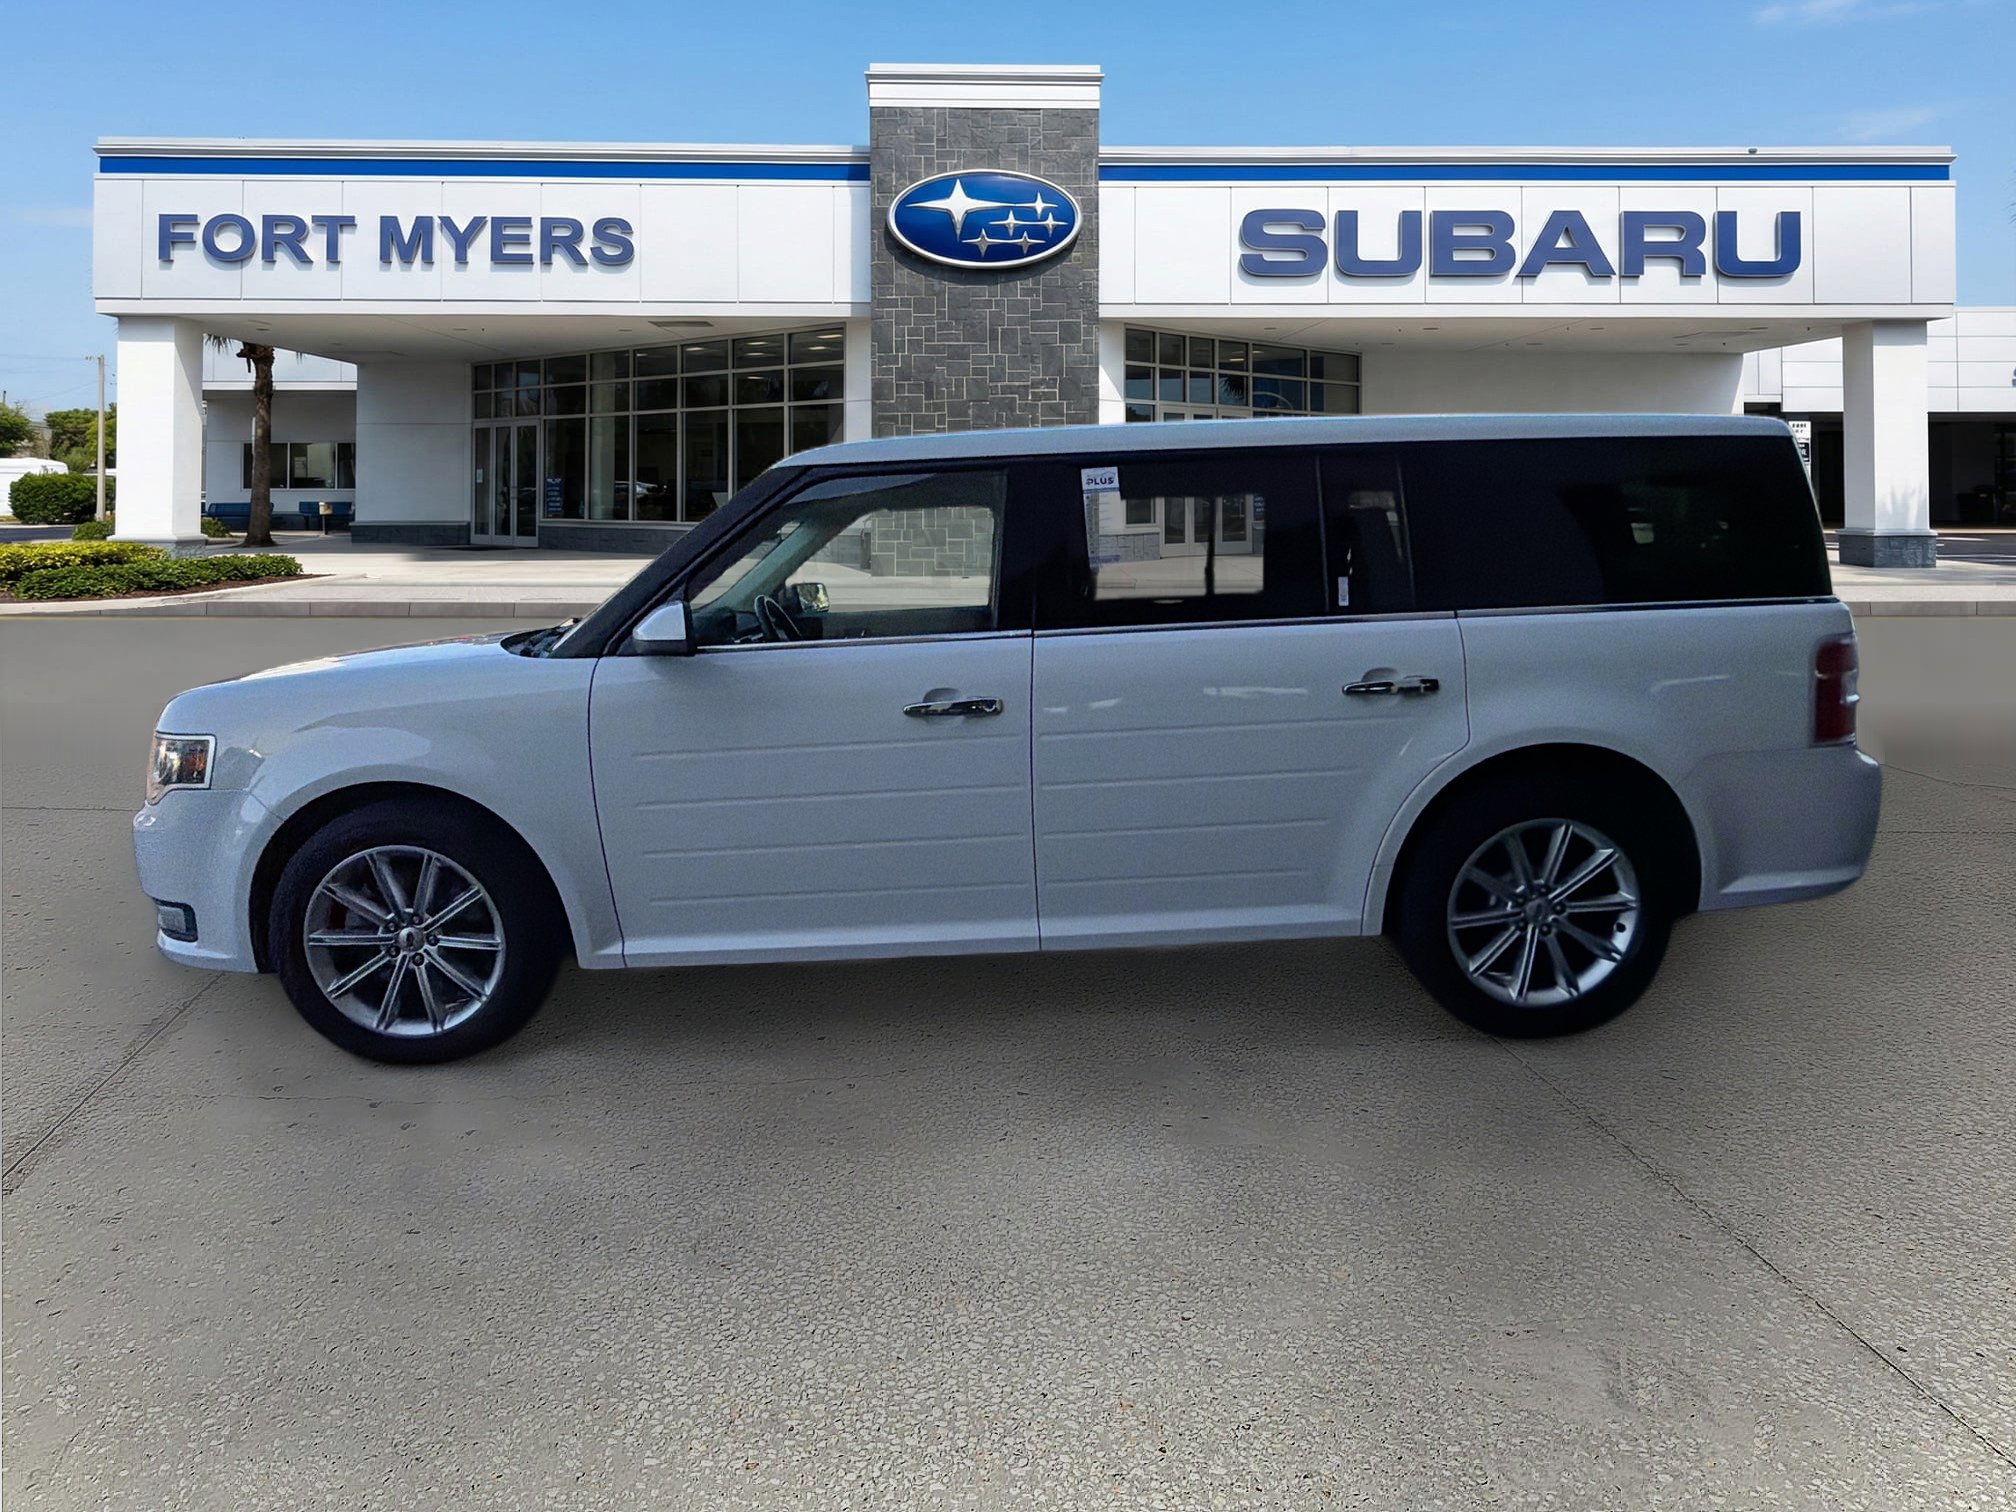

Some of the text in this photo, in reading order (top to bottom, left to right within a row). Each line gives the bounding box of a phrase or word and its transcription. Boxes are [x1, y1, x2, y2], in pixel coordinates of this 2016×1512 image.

[158, 213, 636, 267] FORT MYERS
[1239, 208, 1802, 279] SUBARU
[1085, 477, 1115, 486] PLUS
